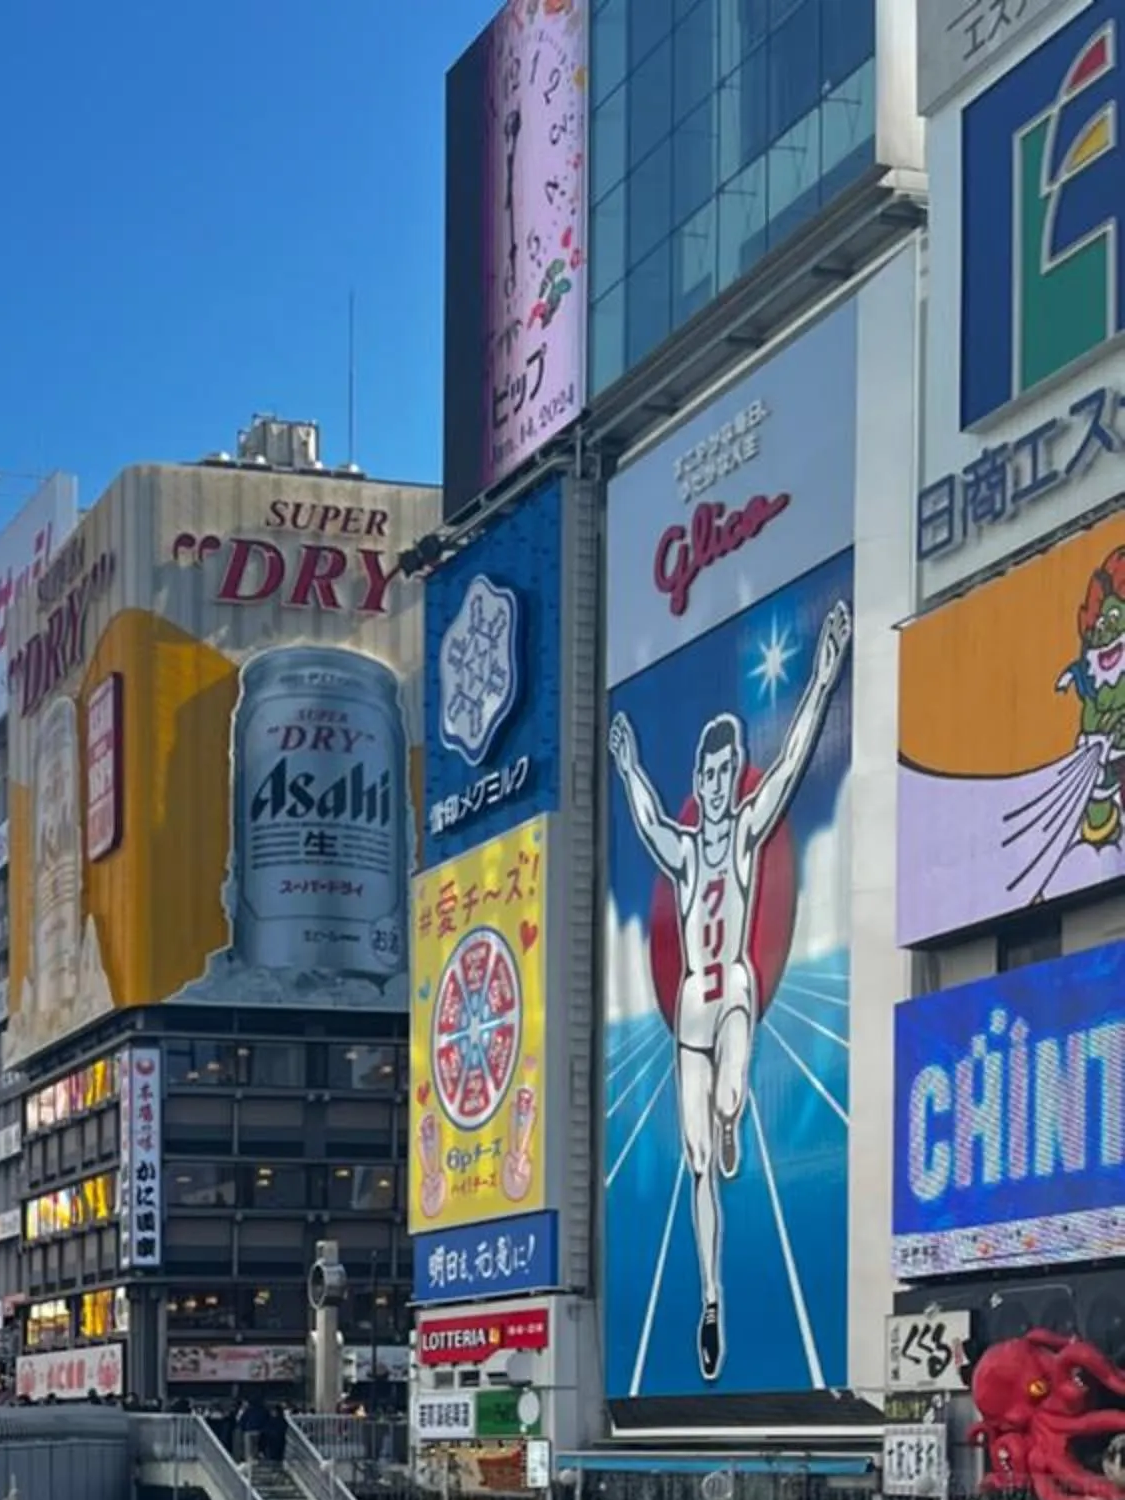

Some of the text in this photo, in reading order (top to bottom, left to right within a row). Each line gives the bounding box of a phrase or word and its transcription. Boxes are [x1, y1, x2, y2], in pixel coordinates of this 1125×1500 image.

[962, 0, 1027, 61] エス
[917, 385, 1125, 560] 日商エス
[265, 500, 389, 536] SUPER
[654, 492, 791, 617] Glico
[250, 758, 391, 827] Asahi
[428, 755, 529, 834] 雪印メグミルク
[303, 830, 338, 857] 生
[702, 878, 725, 1003] グリコ
[422, 1327, 487, 1351] LOTTERIA
[902, 1322, 951, 1378] くくる
